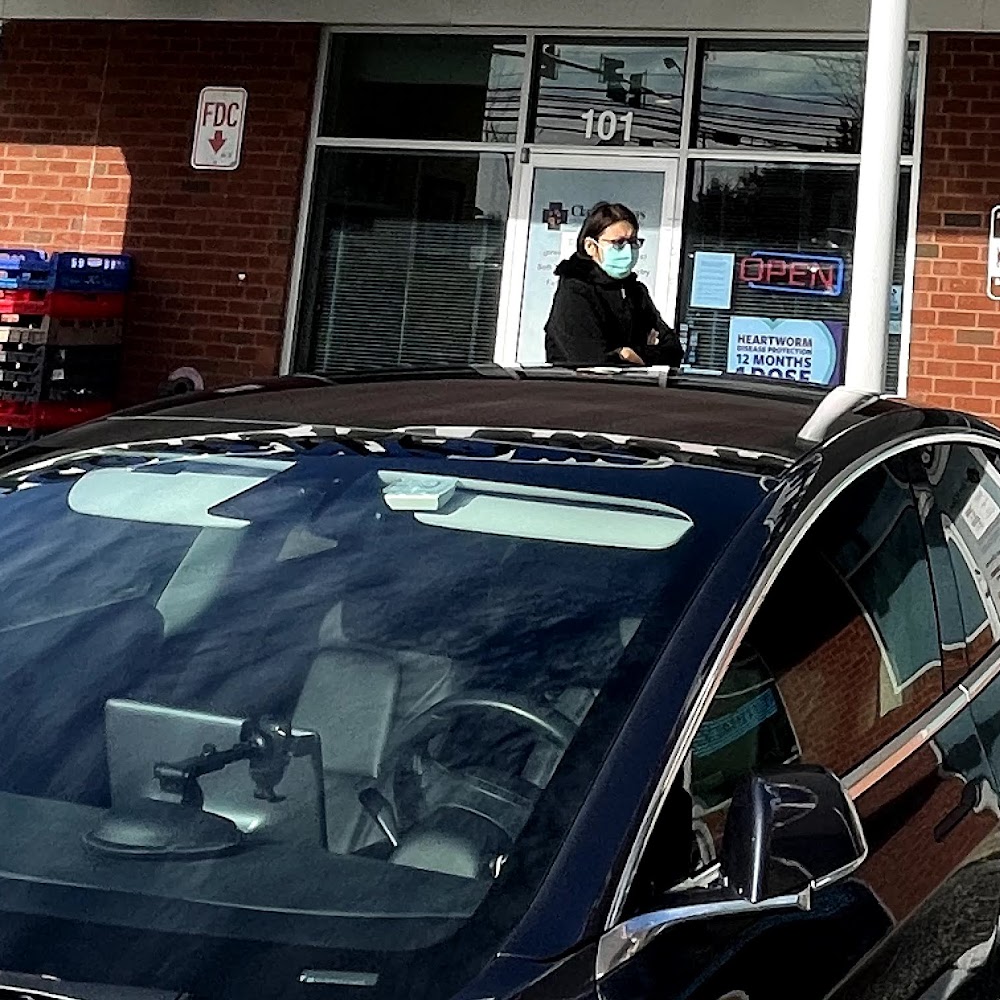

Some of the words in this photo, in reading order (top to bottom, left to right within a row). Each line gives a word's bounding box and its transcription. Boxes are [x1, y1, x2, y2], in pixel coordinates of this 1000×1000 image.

[202, 102, 240, 127] FDC
[582, 109, 634, 142] 101
[740, 257, 834, 289] OPEN
[736, 345, 766, 353] DISEASE
[768, 347, 812, 355] PROTECTION
[737, 334, 813, 347] HEARTWORM
[736, 354, 750, 364] 12
[753, 355, 812, 368] MONTHS
